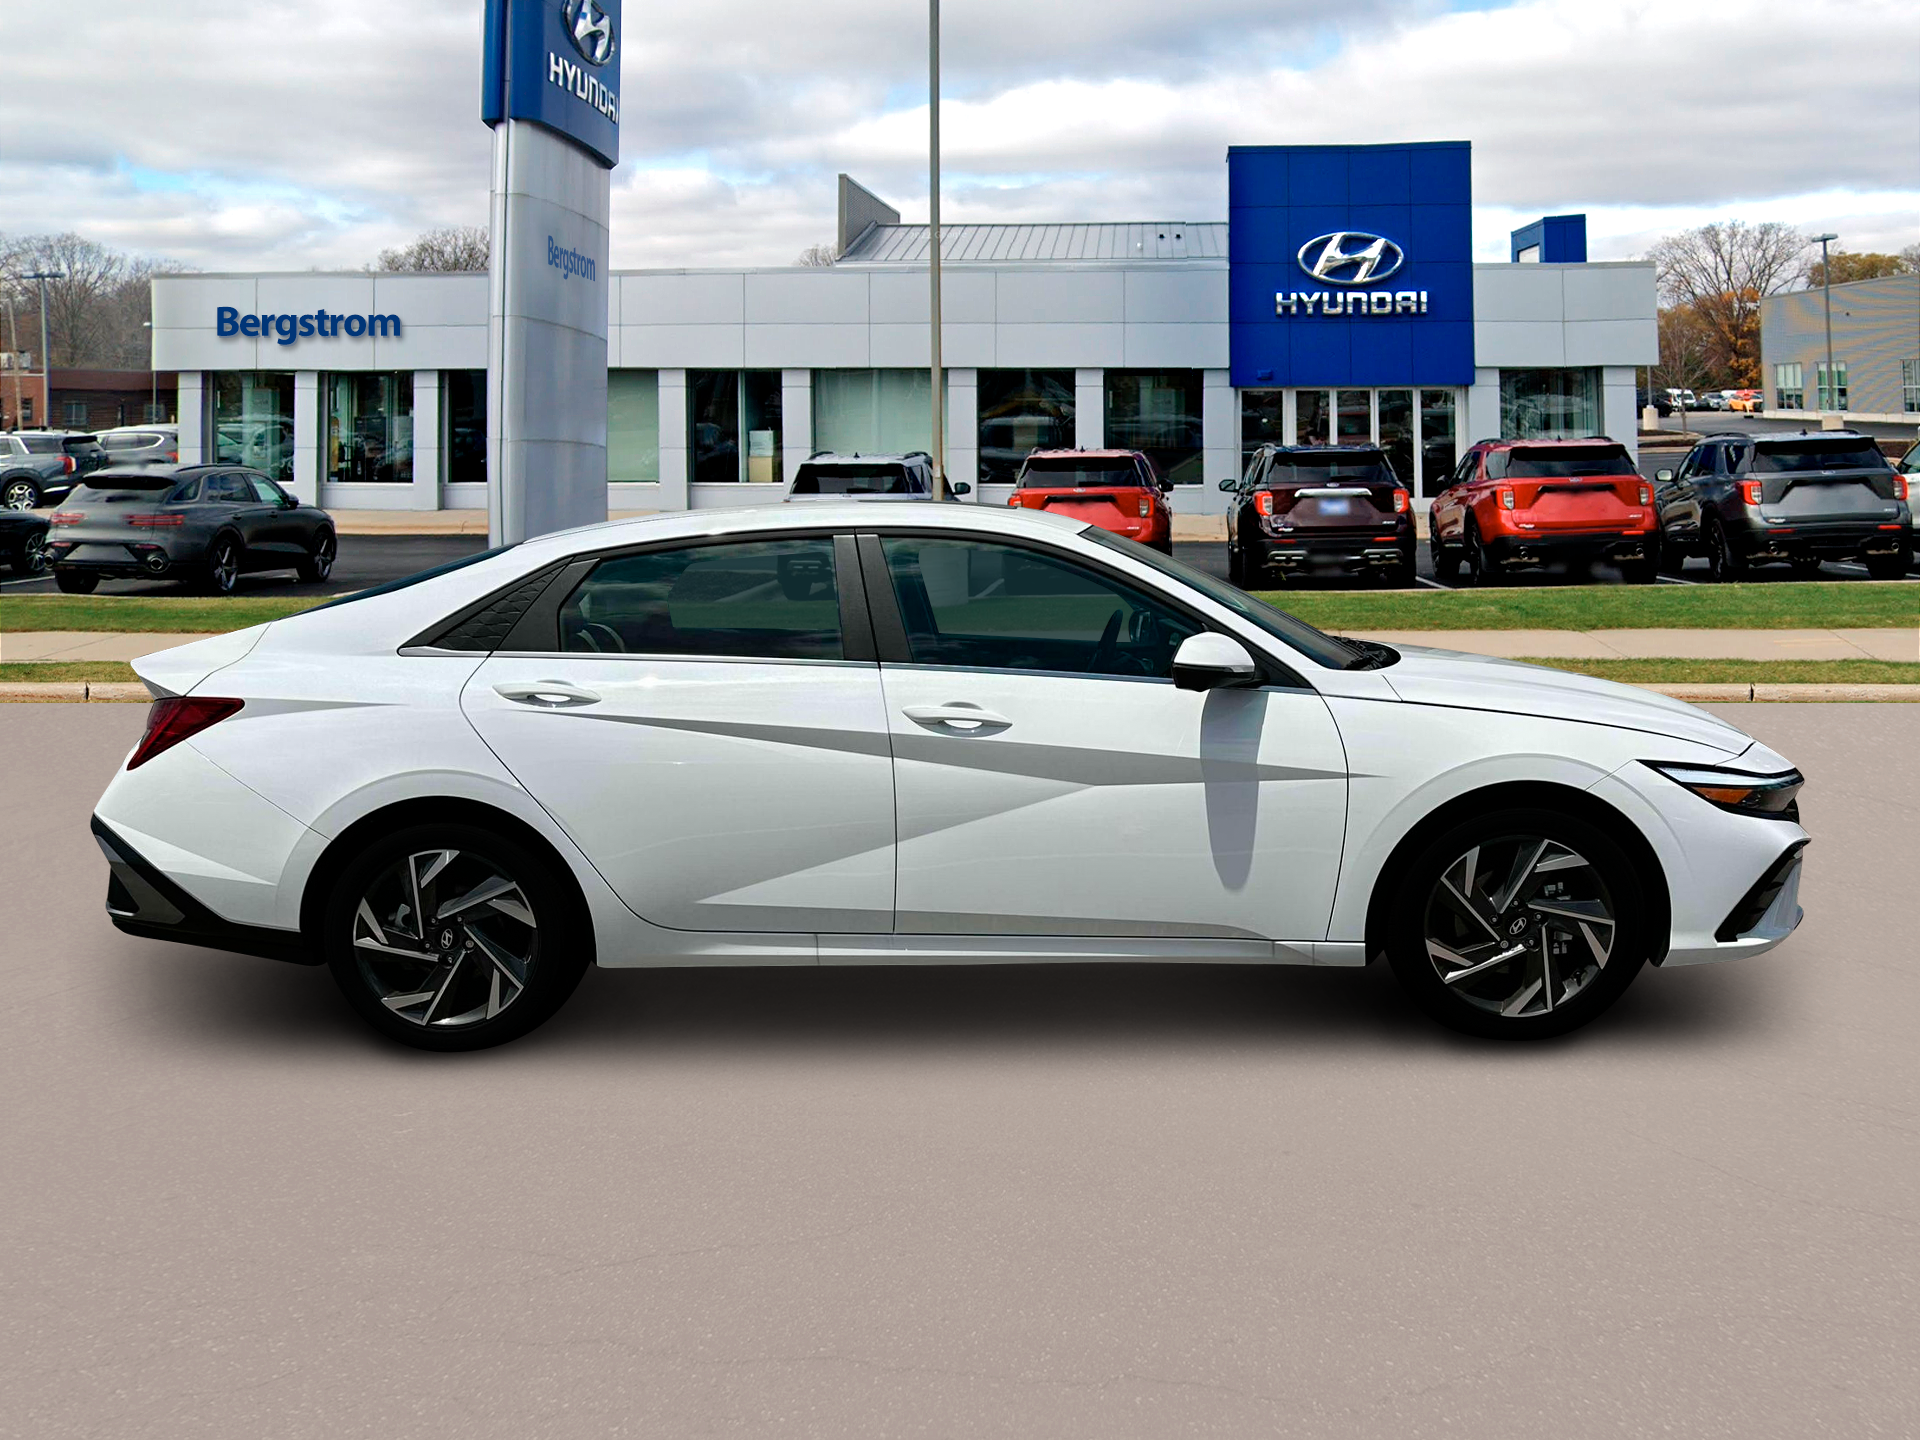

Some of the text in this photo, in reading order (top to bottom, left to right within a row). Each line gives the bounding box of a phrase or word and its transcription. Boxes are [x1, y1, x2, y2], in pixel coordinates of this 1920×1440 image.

[549, 51, 619, 125] HYUNDAI
[548, 235, 596, 282] Bergstrom
[1275, 291, 1428, 315] HYUNDAI
[216, 306, 402, 346] Bergstrom
